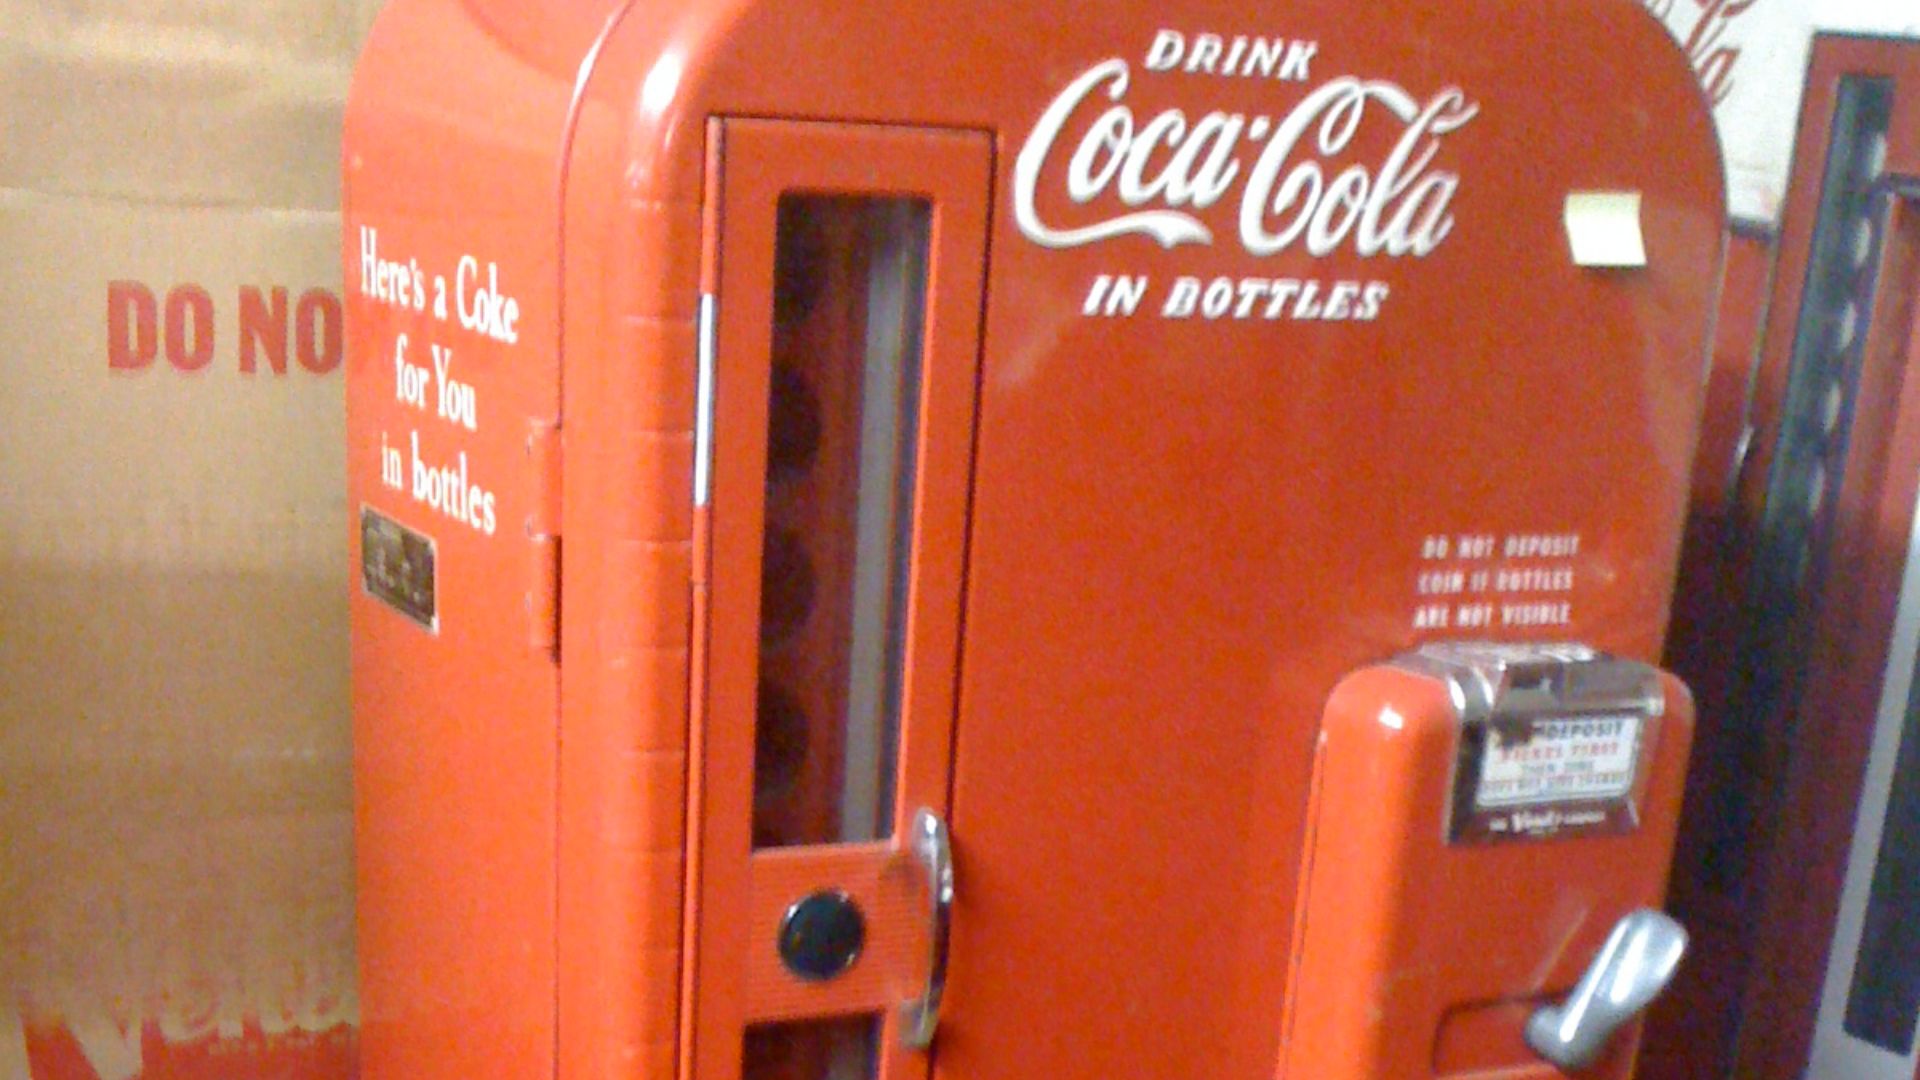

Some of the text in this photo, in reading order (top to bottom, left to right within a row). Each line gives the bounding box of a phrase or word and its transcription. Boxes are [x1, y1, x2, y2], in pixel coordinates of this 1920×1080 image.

[1145, 29, 1318, 81] DRINK
[1014, 58, 1480, 257] Coca-Cola
[360, 225, 519, 344] Here's a Coke
[1083, 274, 1390, 321] IN BOTTLES
[107, 280, 214, 372] DO
[396, 333, 477, 431] for You
[382, 430, 496, 536] in bottles
[1422, 533, 1580, 559] DO NOT DEPOSIT
[1496, 566, 1574, 591] BOTTLES
[1413, 600, 1571, 628] ARE NOT VISIBLE
